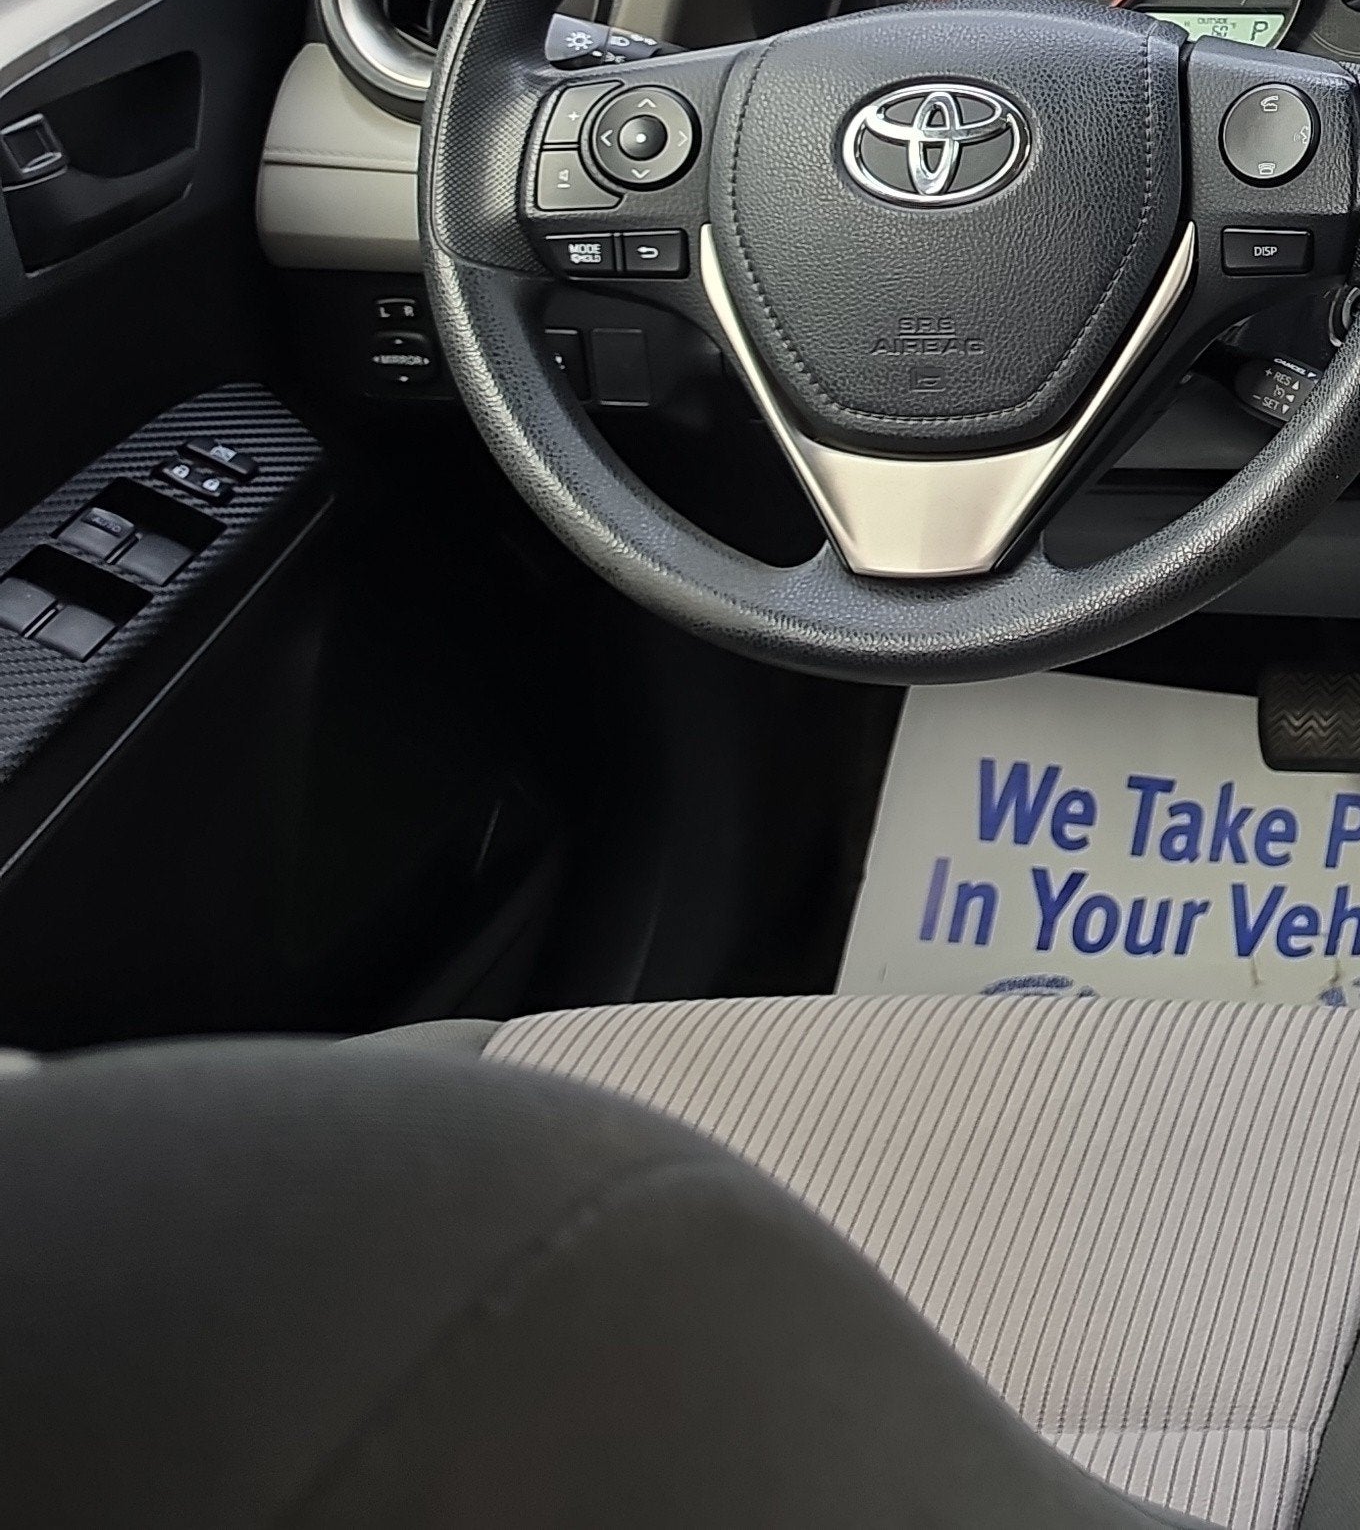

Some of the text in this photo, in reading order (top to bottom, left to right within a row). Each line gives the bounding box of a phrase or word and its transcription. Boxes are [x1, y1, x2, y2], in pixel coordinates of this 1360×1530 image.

[1250, 20, 1269, 42] P
[567, 243, 602, 255] MODE
[1253, 246, 1278, 257] DISP
[379, 305, 415, 318] L R
[898, 316, 955, 333] SRS
[870, 337, 985, 356] AIRBAG
[380, 354, 423, 366] MIRROR
[1273, 357, 1307, 376] CANCEL
[1273, 371, 1292, 387] RES
[1262, 396, 1281, 411] SET
[977, 756, 1097, 852] We
[1125, 774, 1300, 869] Take
[918, 856, 1000, 947] In
[1031, 864, 1211, 957] Your
